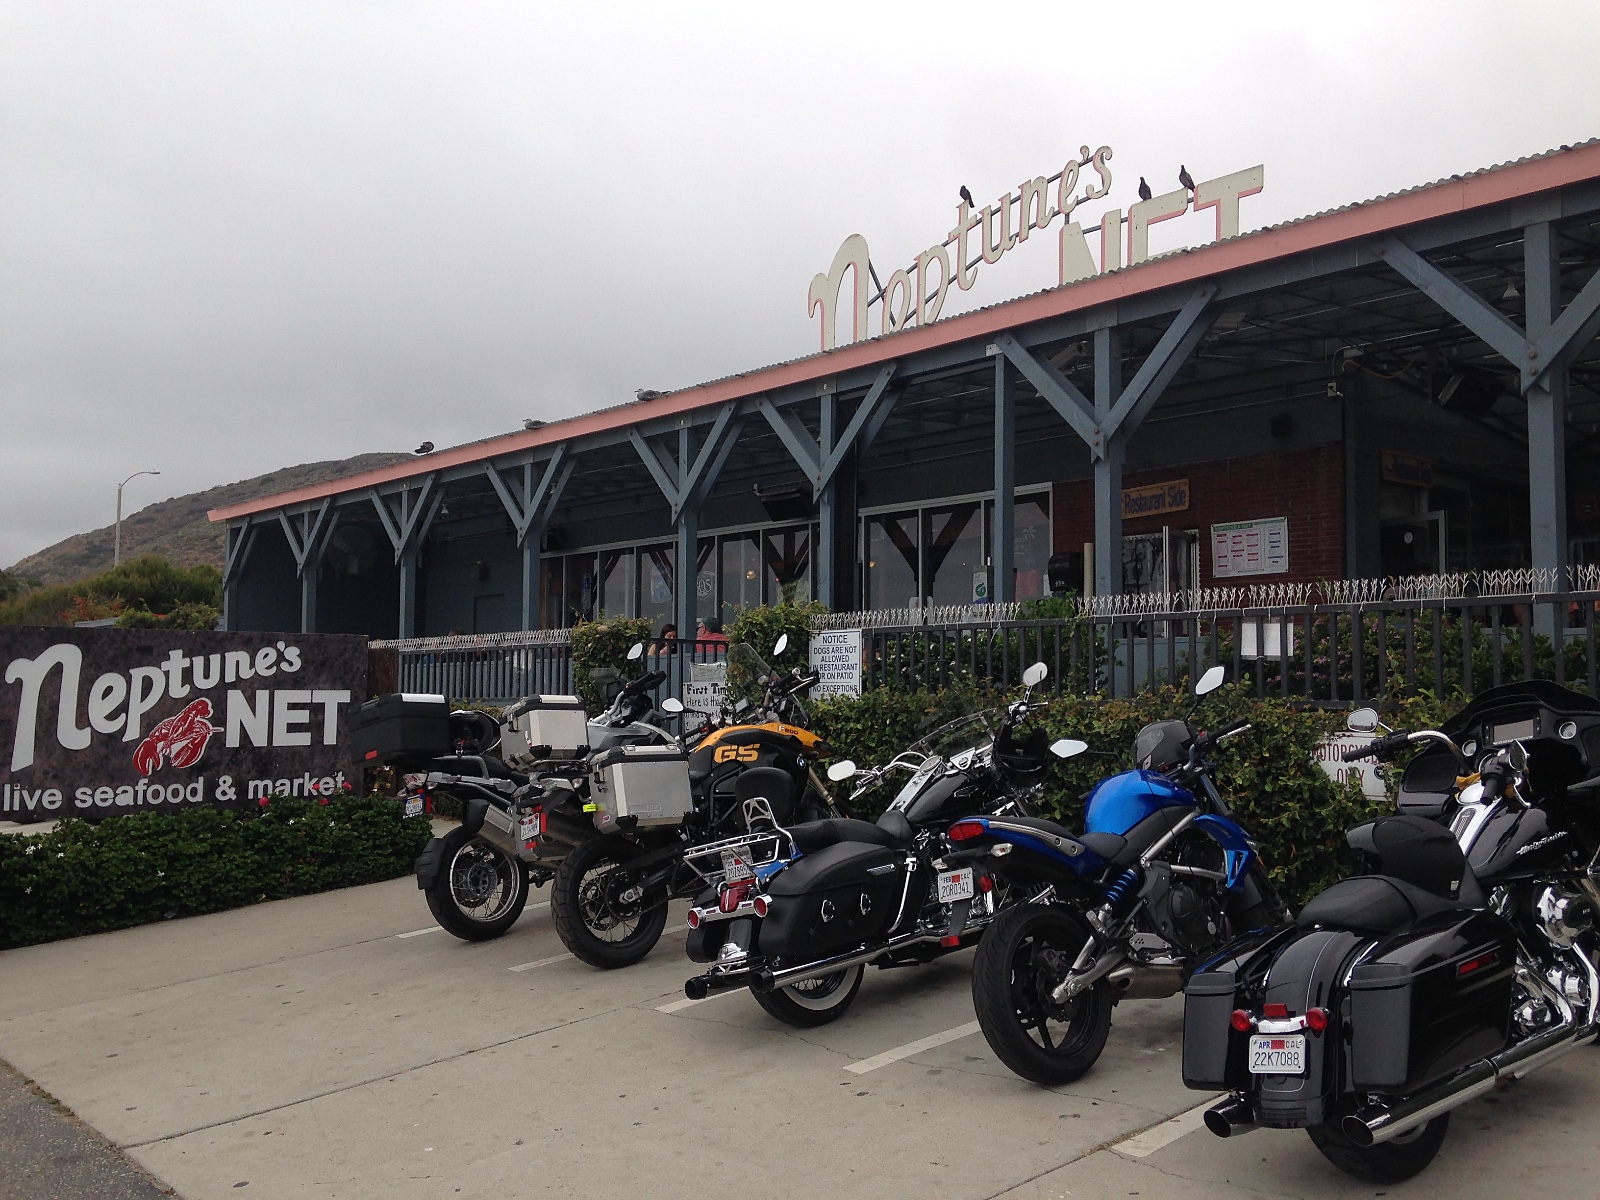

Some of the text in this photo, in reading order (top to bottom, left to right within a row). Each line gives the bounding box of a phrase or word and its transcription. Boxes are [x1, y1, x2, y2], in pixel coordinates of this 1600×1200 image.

[1124, 484, 1186, 514] Restaurant Side
[822, 635, 848, 644] NOTICE
[813, 645, 858, 655] DOGS ARE NOT
[820, 655, 850, 663] ALLOWED
[819, 663, 858, 672] RESTAURANT
[826, 672, 836, 680] ON
[836, 672, 854, 680] PATIO
[710, 682, 728, 695] Tim
[812, 684, 858, 693] NO EXCEPTIONS
[5, 641, 302, 772] Neptune's
[686, 697, 702, 707] Here
[703, 697, 709, 707] is
[225, 689, 350, 748] NET
[713, 743, 760, 764] GS
[1337, 768, 1365, 788] OY
[3, 771, 345, 811] live seafood & market
[1258, 1040, 1300, 1049] APR CAL
[1254, 1052, 1300, 1066] 22K7088
